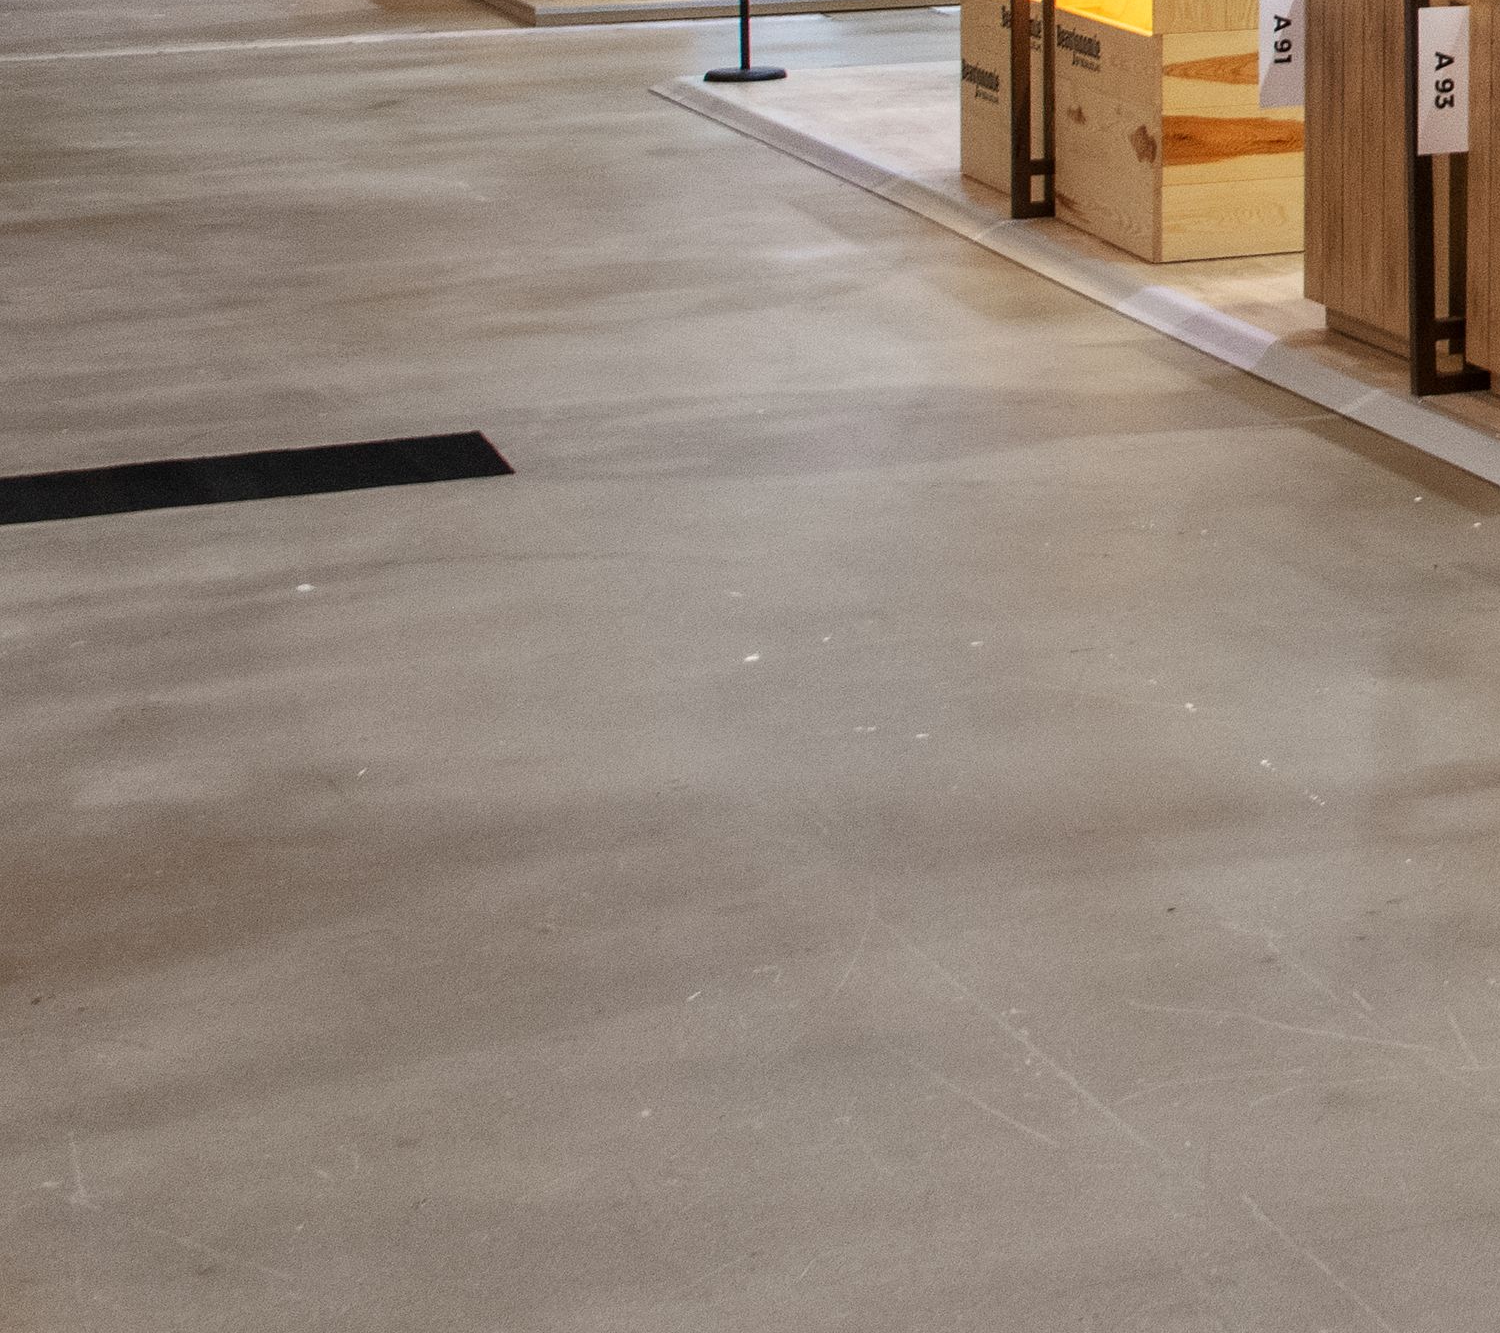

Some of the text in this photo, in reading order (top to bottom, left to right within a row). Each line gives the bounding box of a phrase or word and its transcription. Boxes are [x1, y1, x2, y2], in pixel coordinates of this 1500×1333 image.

[1273, 15, 1291, 66] A 91
[1433, 52, 1454, 111] A 93
